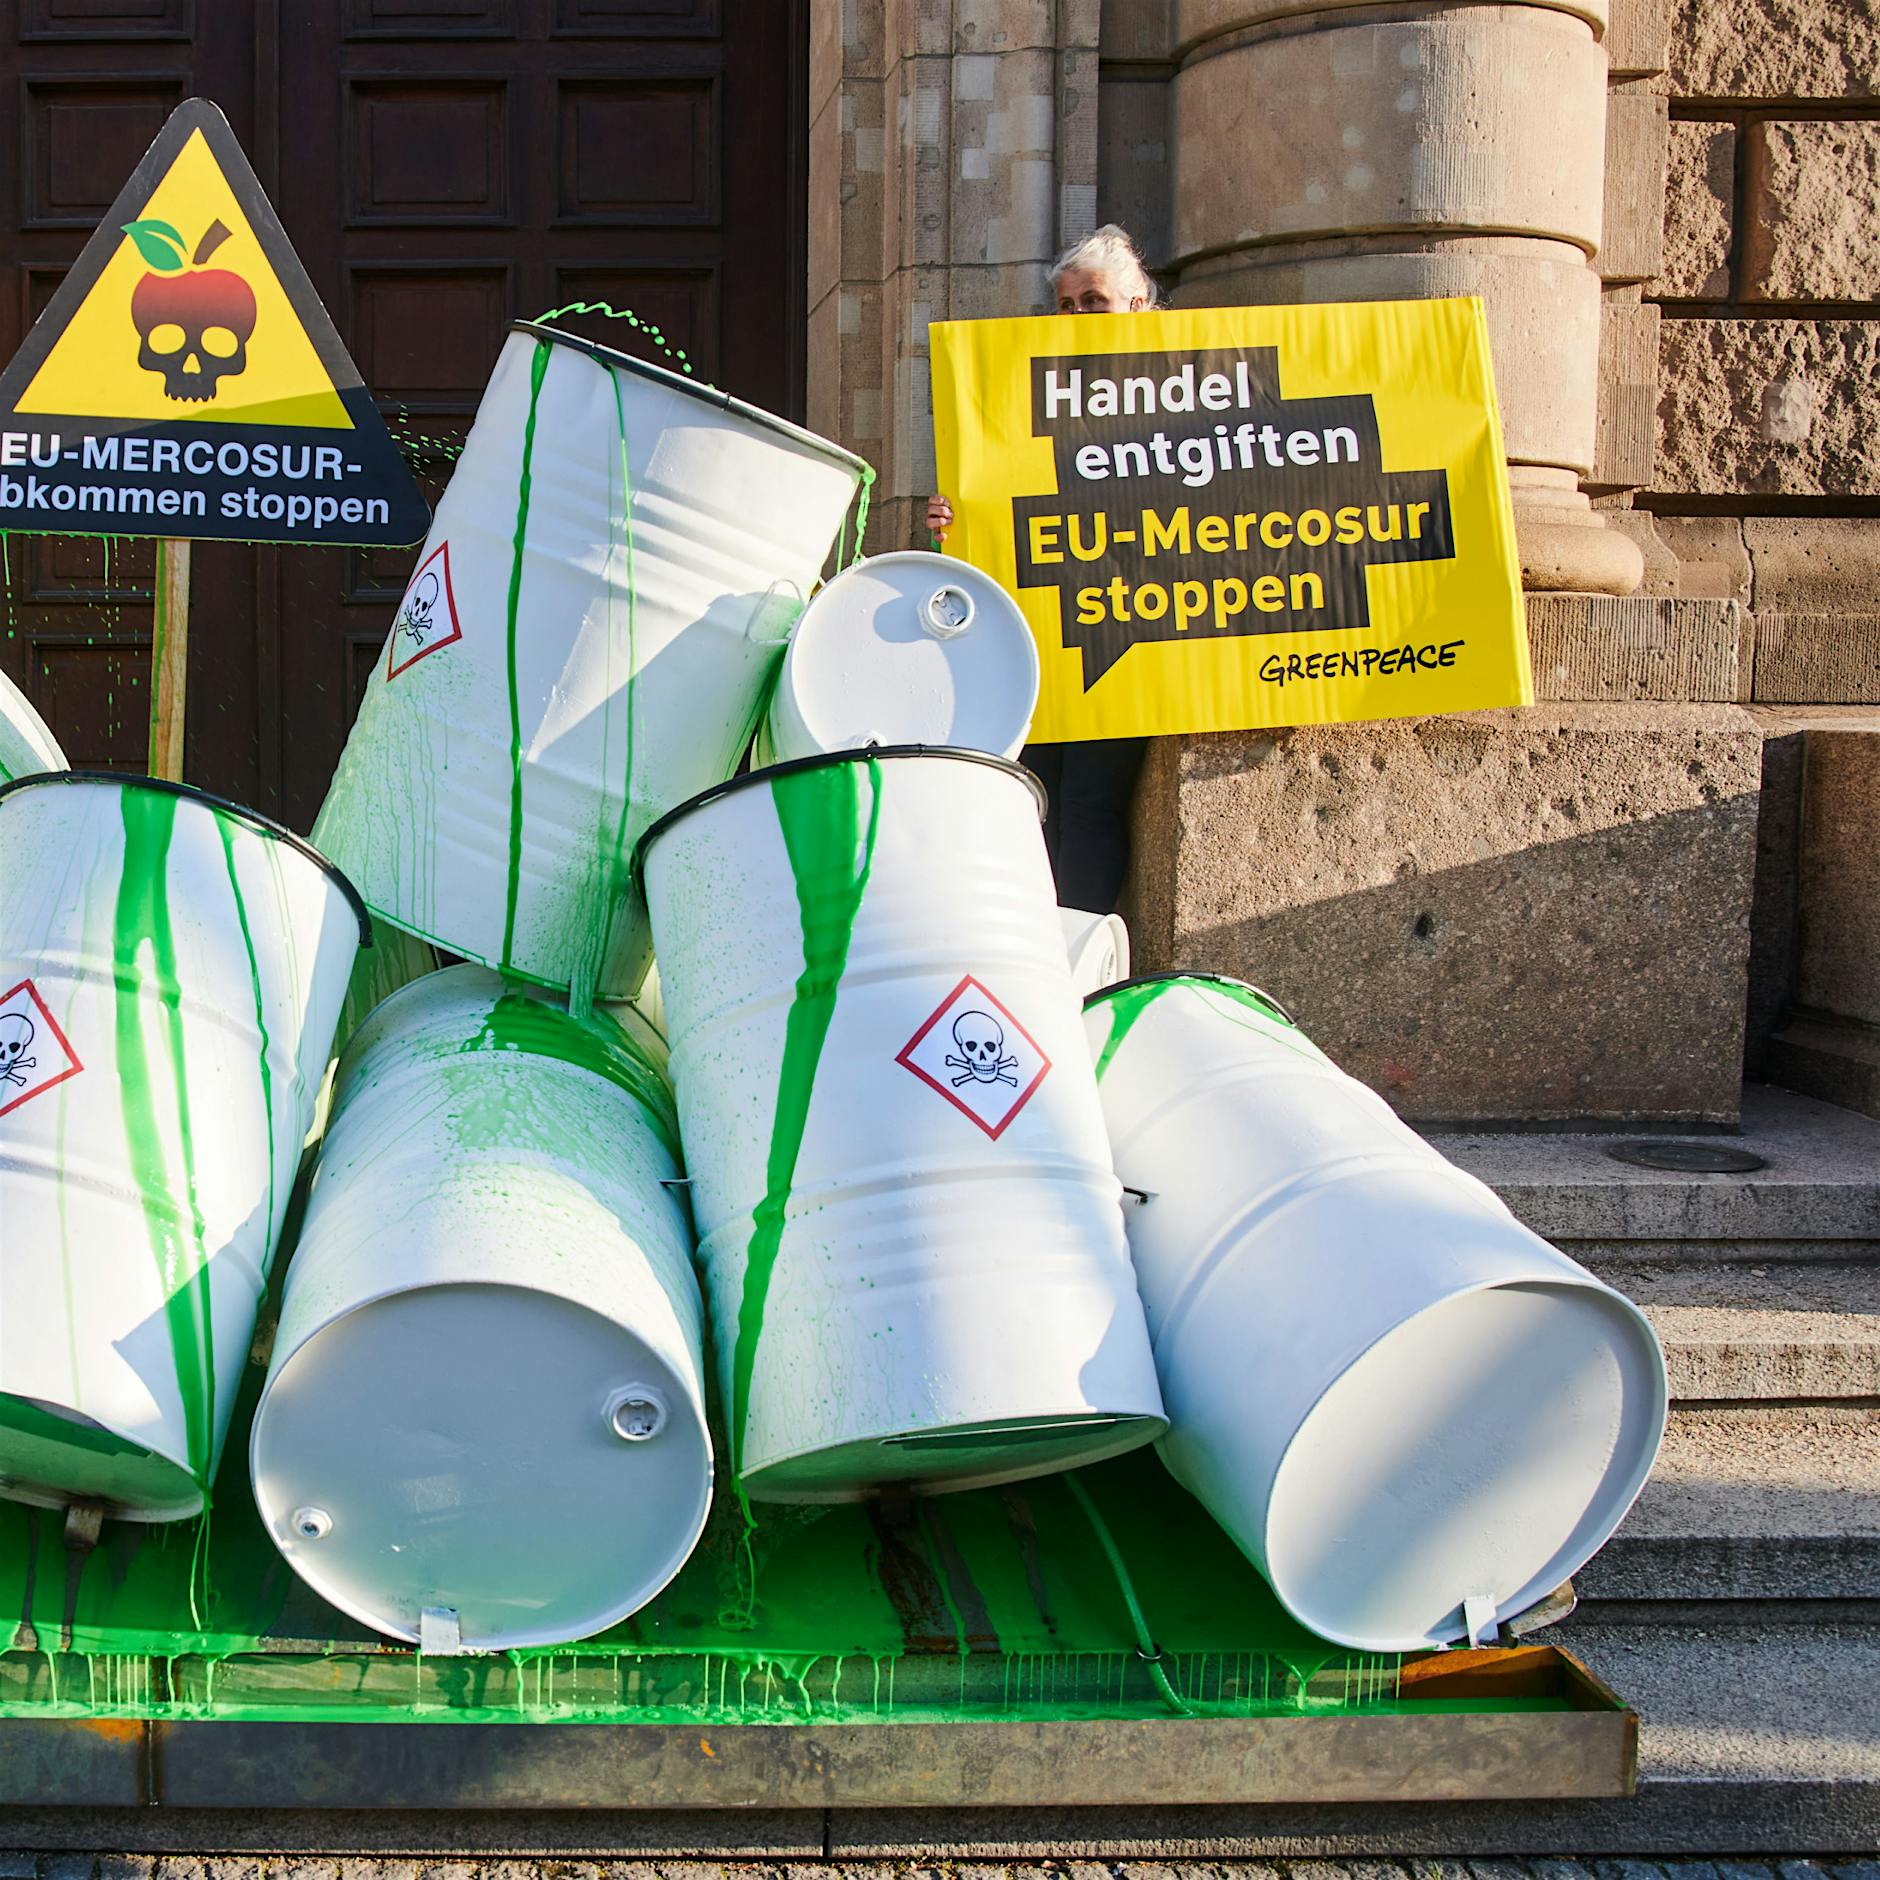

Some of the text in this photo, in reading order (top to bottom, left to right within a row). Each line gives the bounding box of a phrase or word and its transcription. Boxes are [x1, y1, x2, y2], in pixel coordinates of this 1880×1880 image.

[1045, 360, 1251, 419] Handel
[1, 431, 362, 481] EU-MERCOSUR-
[1075, 423, 1360, 488] entgiften
[220, 486, 389, 529] stoppen
[1028, 501, 1431, 565] EU-Mercosur
[1076, 571, 1325, 631] stoppen
[1259, 639, 1466, 688] GREENPEACE
